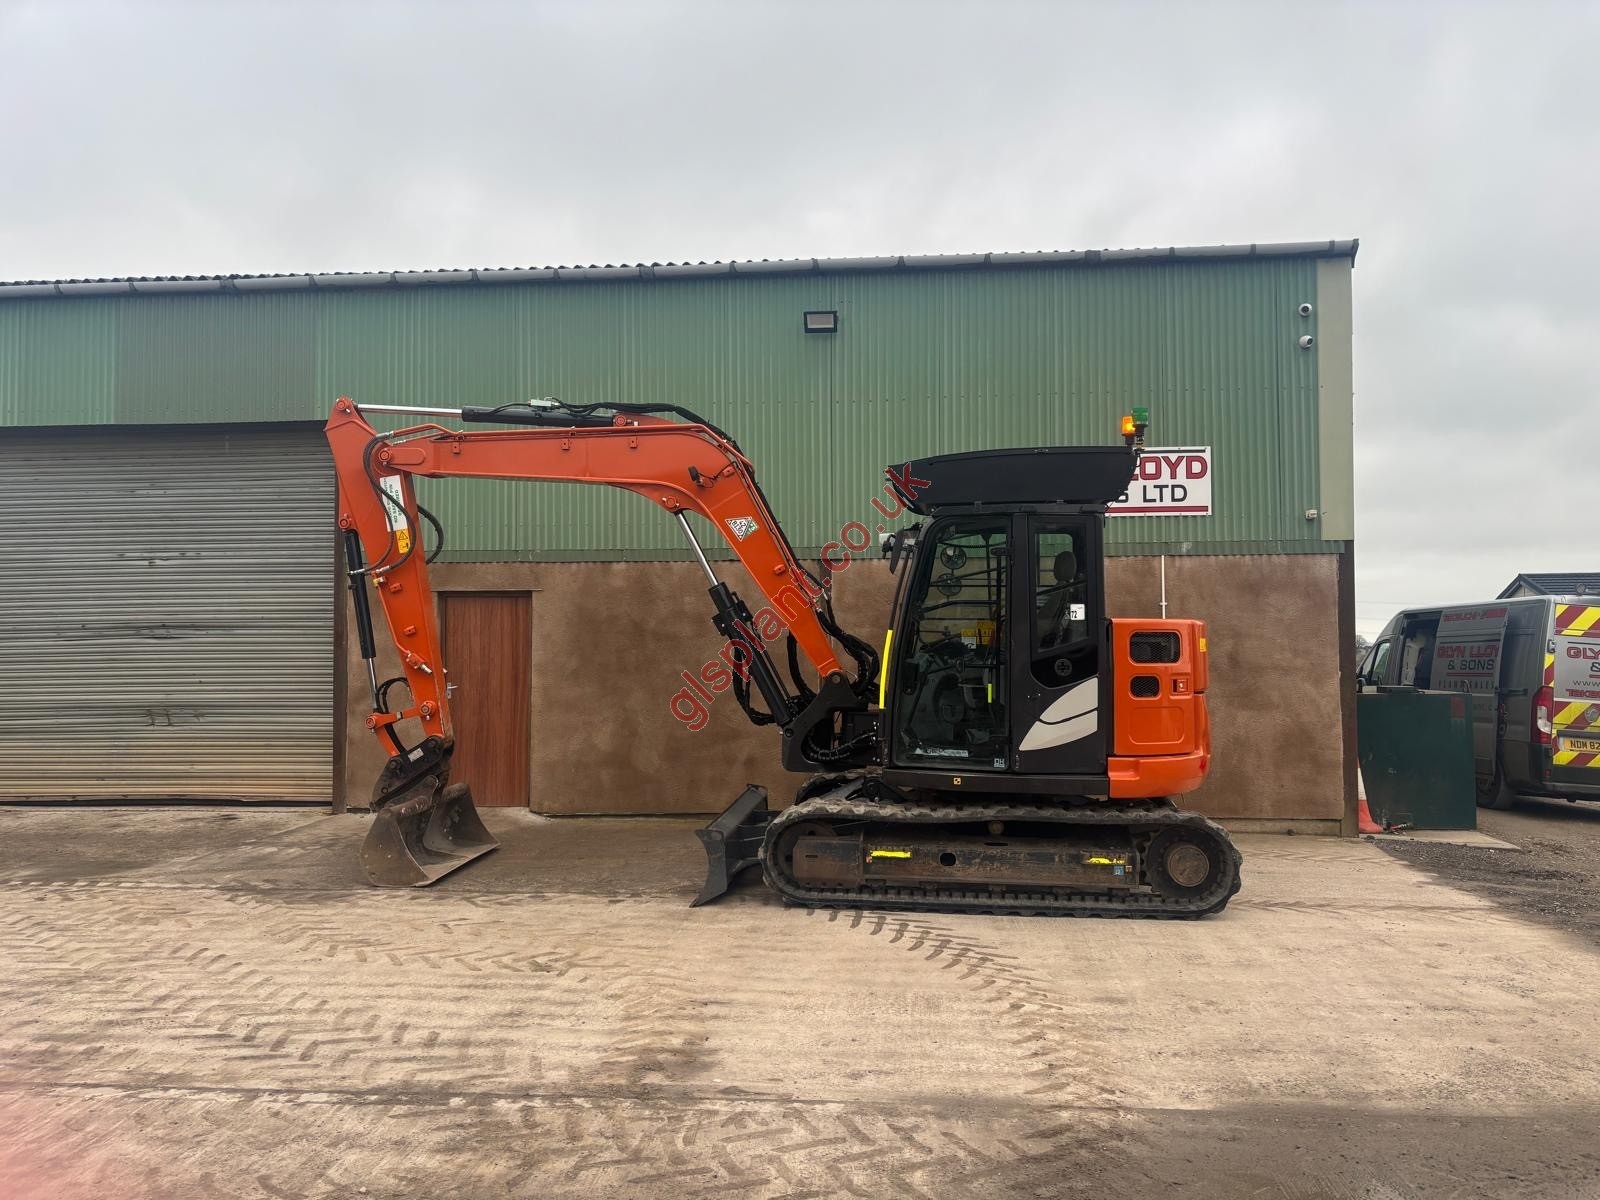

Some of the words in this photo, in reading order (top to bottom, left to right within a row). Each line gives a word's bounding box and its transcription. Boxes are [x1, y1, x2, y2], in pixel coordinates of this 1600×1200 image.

[1131, 455, 1208, 481] OYD
[1143, 484, 1188, 503] LTD
[1447, 659, 1456, 671] &
[1459, 659, 1495, 671] SONS
[1570, 739, 1588, 749] NDM
